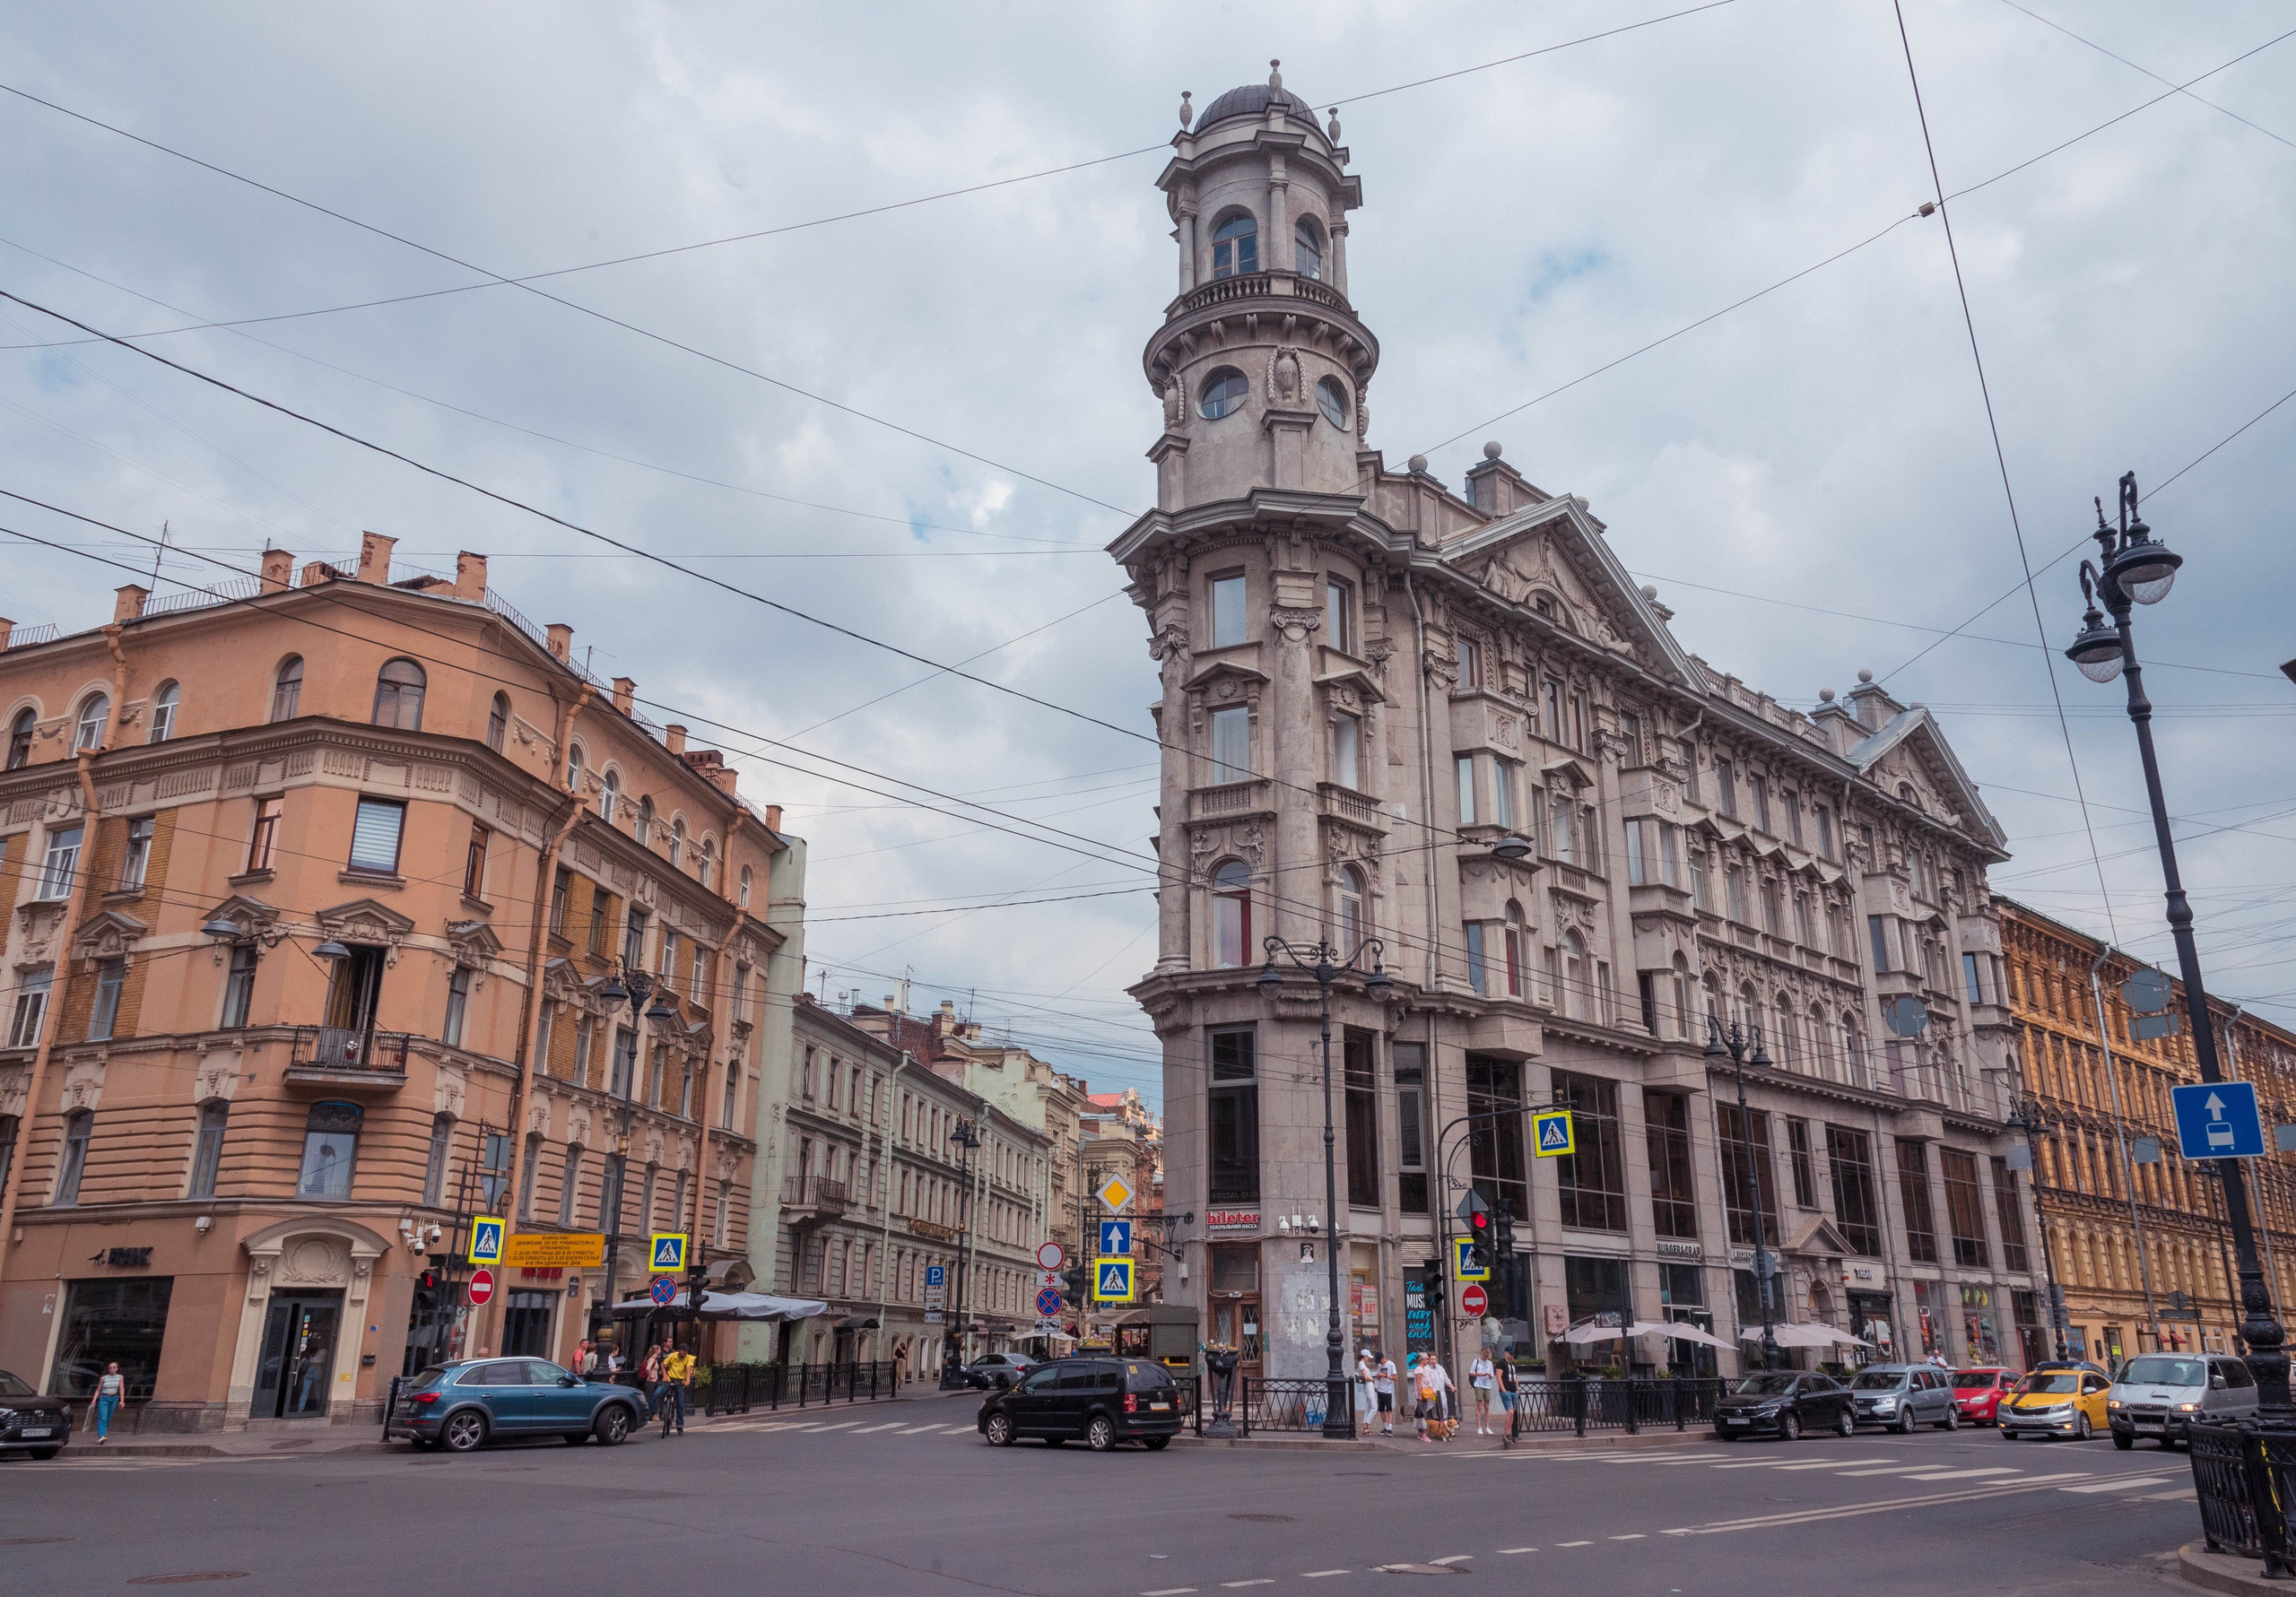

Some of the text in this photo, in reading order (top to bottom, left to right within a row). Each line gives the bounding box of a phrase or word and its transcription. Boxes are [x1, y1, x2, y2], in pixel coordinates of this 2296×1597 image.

[1206, 1211, 1260, 1224] bileter
[1407, 1310, 1431, 1319] EVERY
[1409, 1318, 1431, 1330] week
[1407, 1327, 1432, 1339] ends
